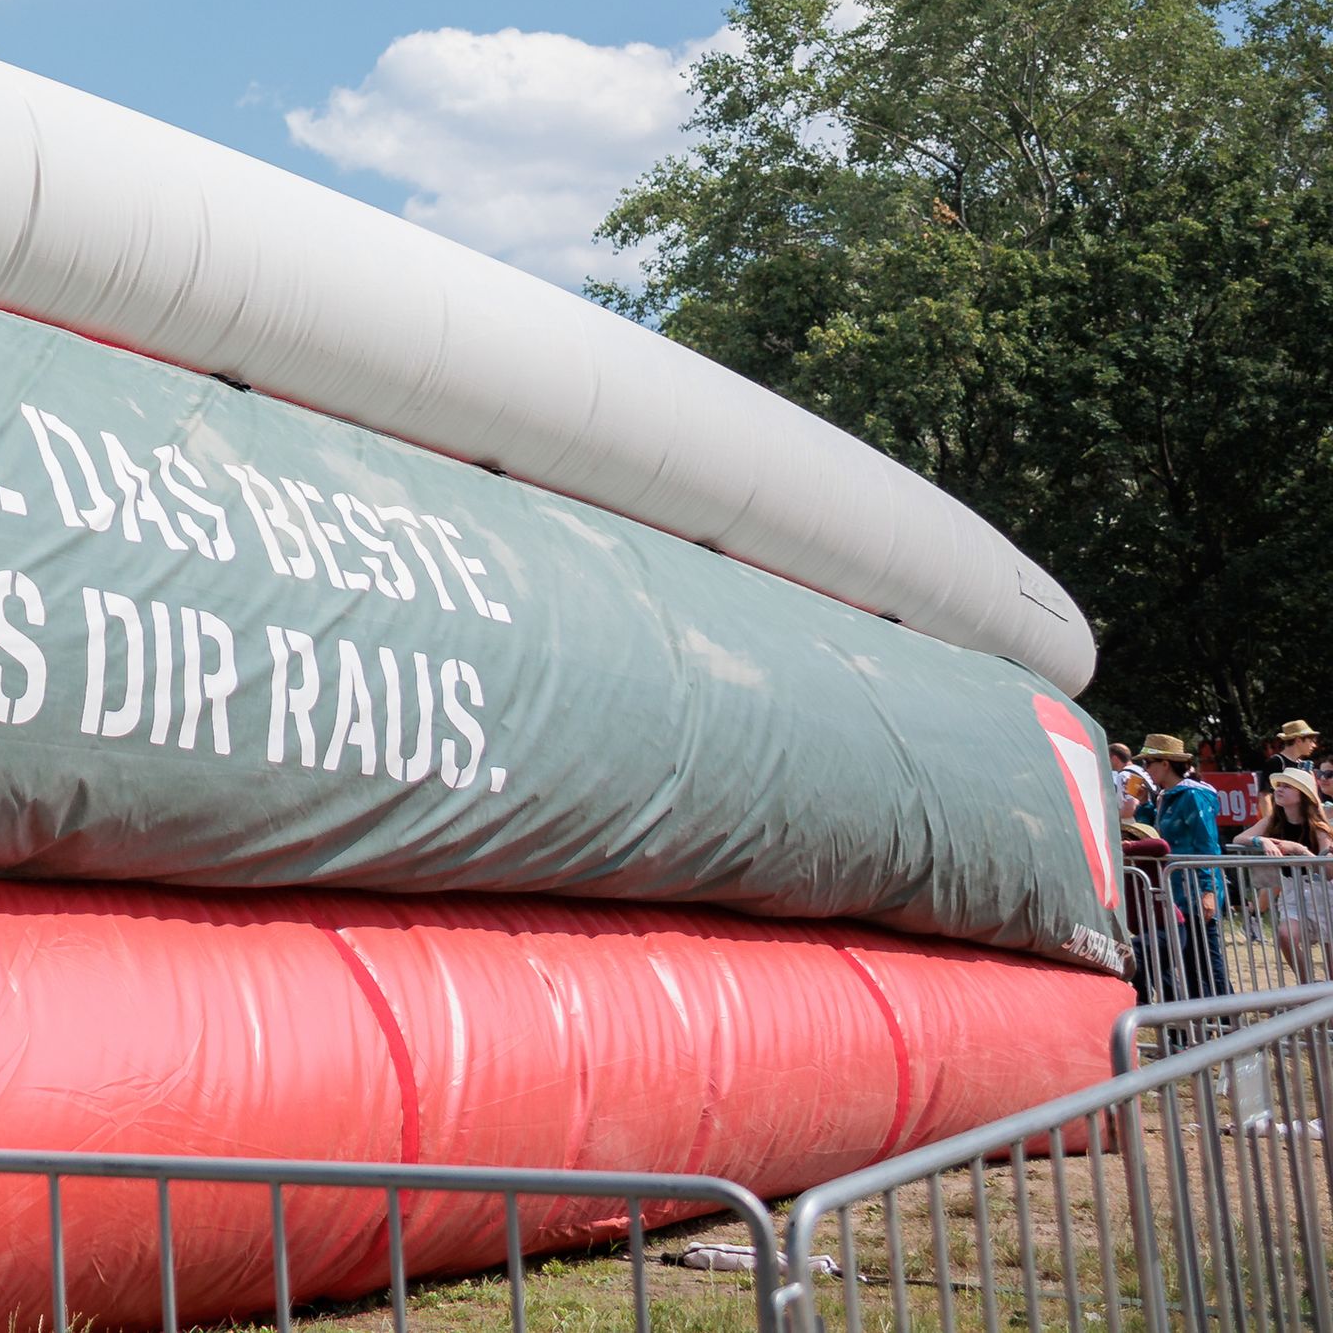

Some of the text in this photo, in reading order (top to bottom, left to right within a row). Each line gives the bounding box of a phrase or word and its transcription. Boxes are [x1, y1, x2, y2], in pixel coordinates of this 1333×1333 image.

[20, 402, 235, 561] DAS
[221, 463, 511, 623] BESTE
[80, 587, 239, 755] DIR
[264, 625, 506, 793] RAUS.
